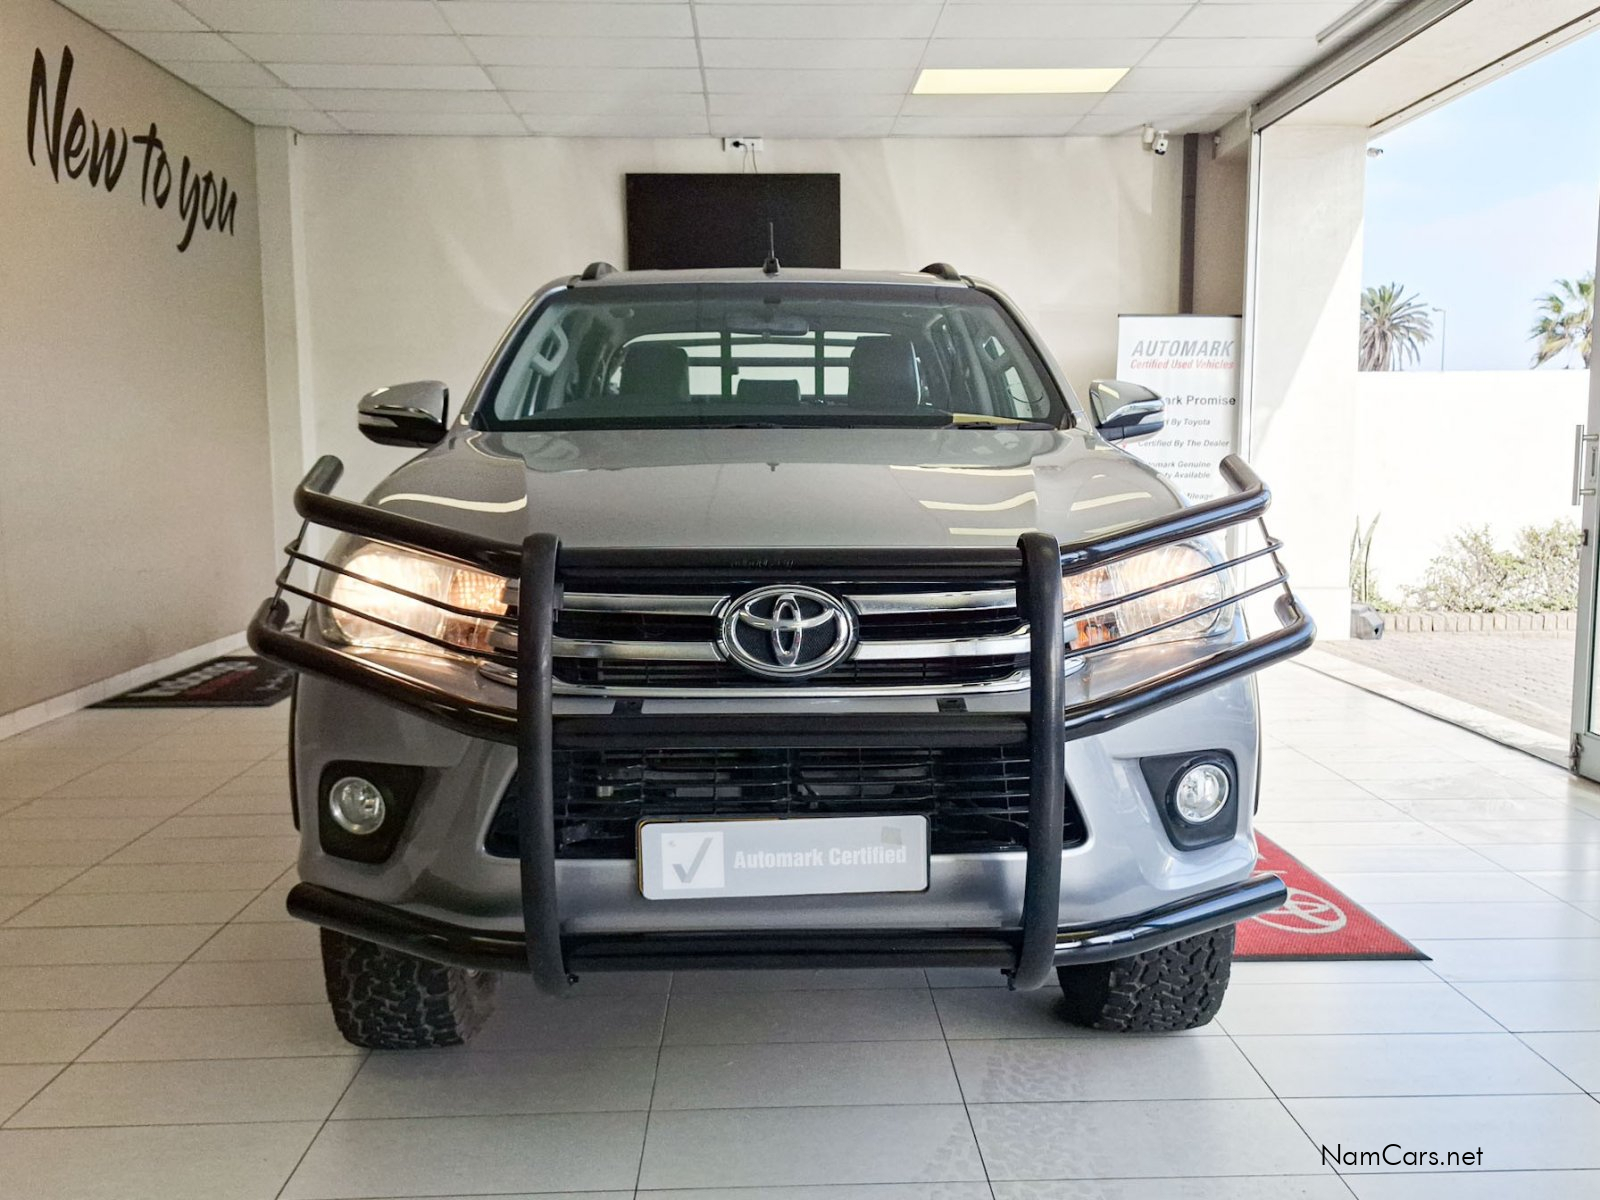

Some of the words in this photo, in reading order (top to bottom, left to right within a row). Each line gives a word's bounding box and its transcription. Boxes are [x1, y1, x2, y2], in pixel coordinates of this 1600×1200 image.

[27, 45, 128, 192] New
[132, 122, 172, 209] to
[176, 155, 238, 253] you
[1131, 340, 1235, 357] AUTOMARK
[1130, 359, 1169, 370] Certified
[1170, 359, 1194, 370] Used
[1196, 359, 1238, 370] Vehicles
[1165, 395, 1182, 405] ark
[1186, 395, 1237, 406] Promise
[1171, 418, 1183, 427] By
[1184, 418, 1211, 427] Toyota
[1138, 440, 1172, 448] Certified
[1173, 440, 1184, 449] By
[1187, 440, 1202, 448] The
[1203, 440, 1230, 448] Dealer
[1177, 460, 1212, 469] Genuine
[1174, 471, 1211, 479] Available
[733, 848, 824, 869] Automark
[828, 846, 908, 865] Certified
